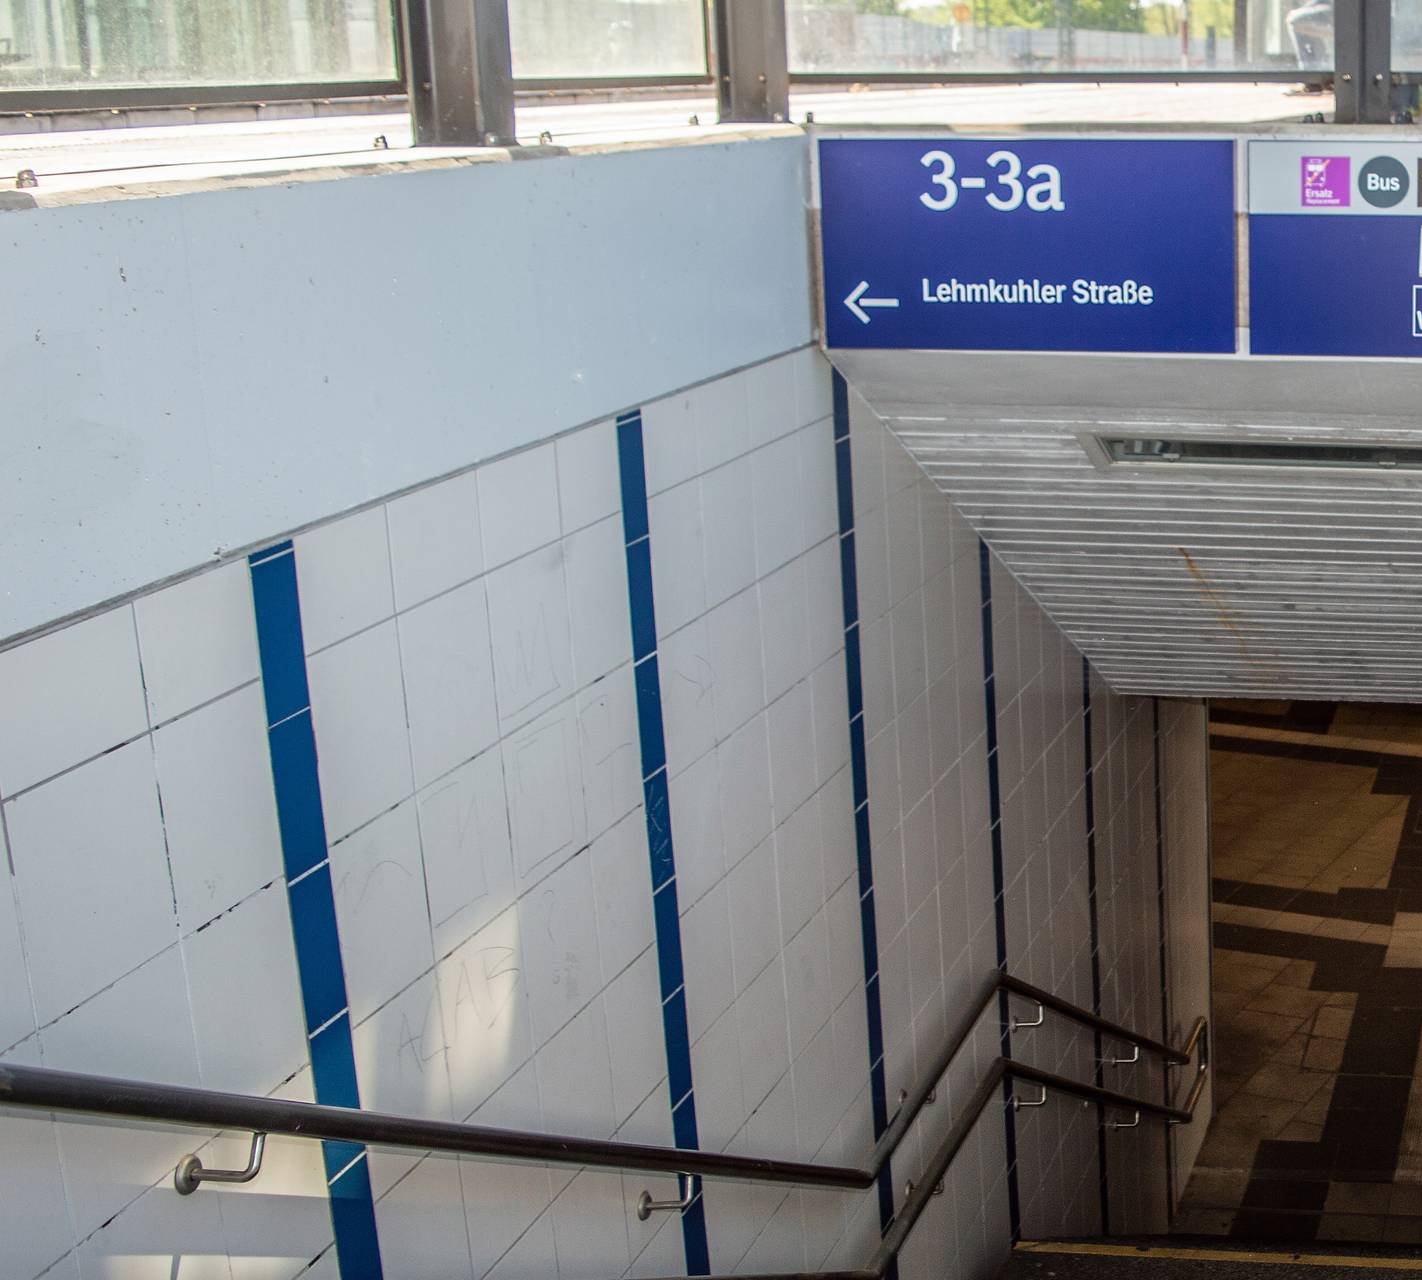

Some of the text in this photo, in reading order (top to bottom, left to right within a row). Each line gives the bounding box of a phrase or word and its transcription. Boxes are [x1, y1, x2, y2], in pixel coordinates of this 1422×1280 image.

[919, 150, 1065, 212] 3-3a
[1367, 173, 1400, 191] Bus
[1305, 188, 1333, 199] Ersatz
[922, 278, 1154, 305] Lehmkuhler Straße
